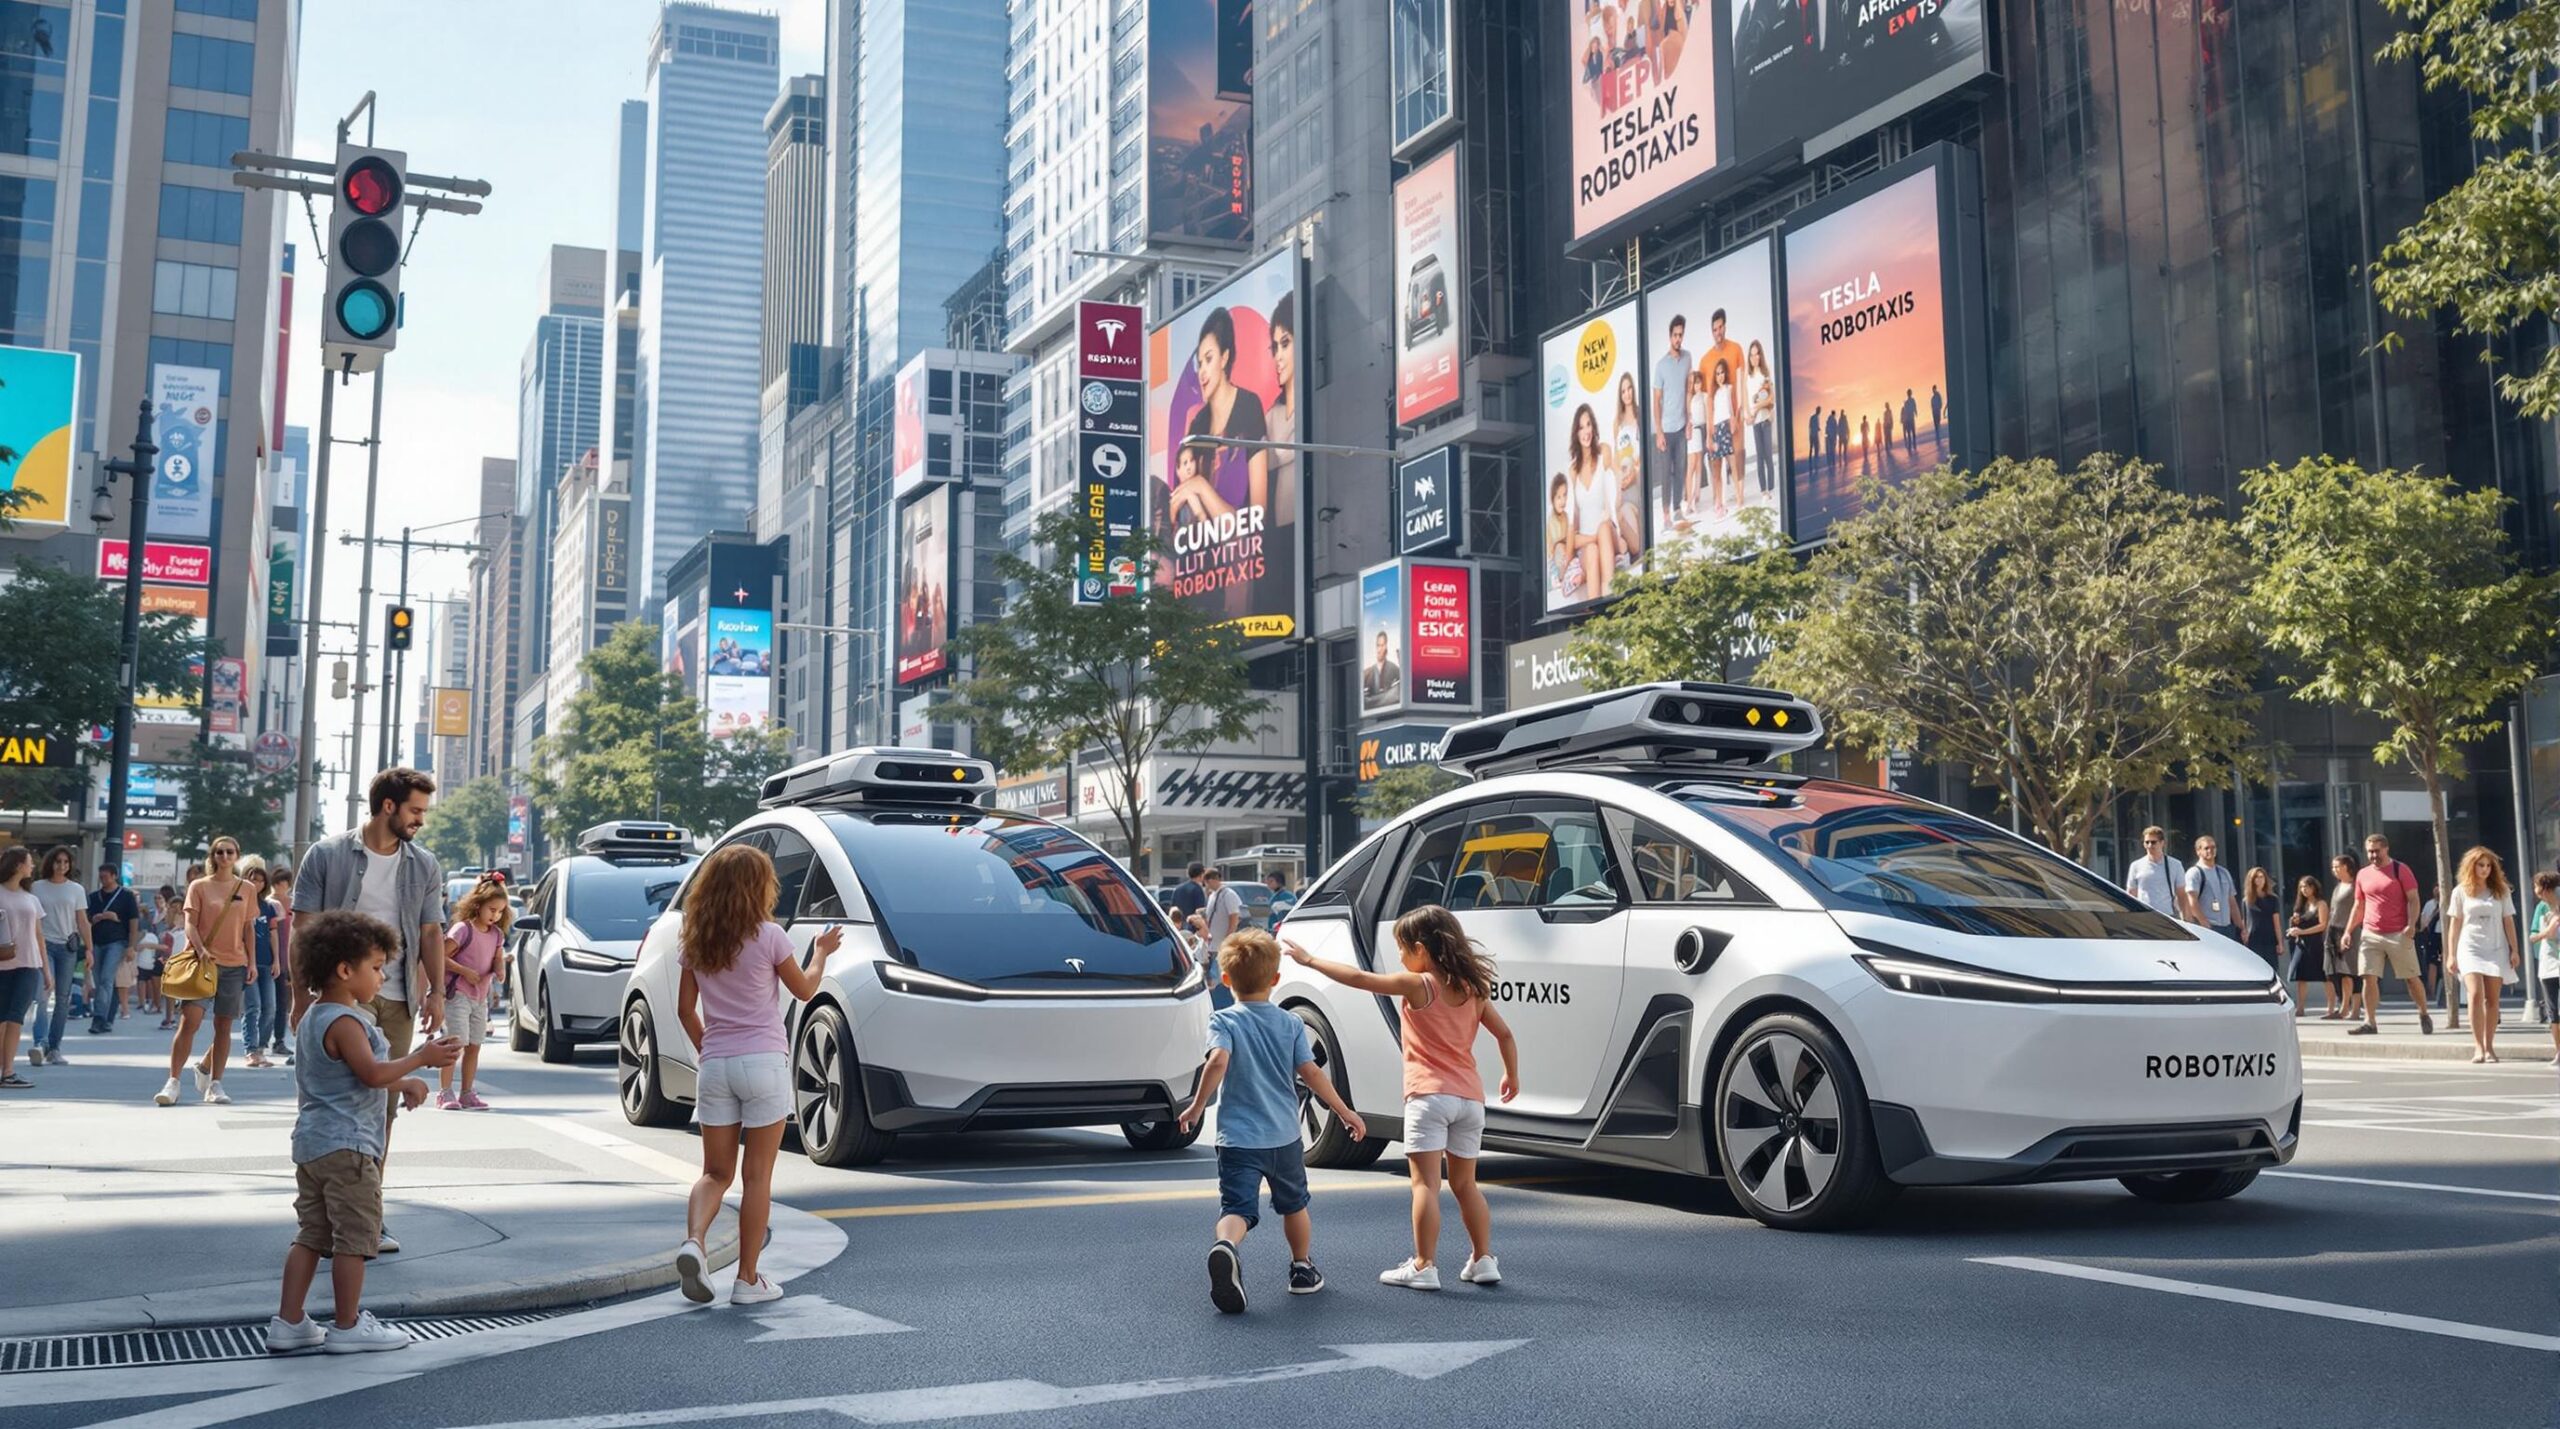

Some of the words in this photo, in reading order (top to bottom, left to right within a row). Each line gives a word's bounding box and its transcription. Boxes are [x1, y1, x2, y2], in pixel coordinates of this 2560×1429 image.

[1600, 84, 1678, 155] TESLAY
[1580, 113, 1699, 207] ROBOTAXIS
[1819, 270, 1881, 314] TESLA
[1820, 291, 1915, 346] ROBOTAXIS
[1173, 504, 1265, 555] CUNDER
[1211, 535, 1264, 567] YITUR
[1173, 556, 1265, 600] ROBOTAXIS
[0, 736, 46, 765] AN
[1490, 981, 1571, 1005] BOTAXIS
